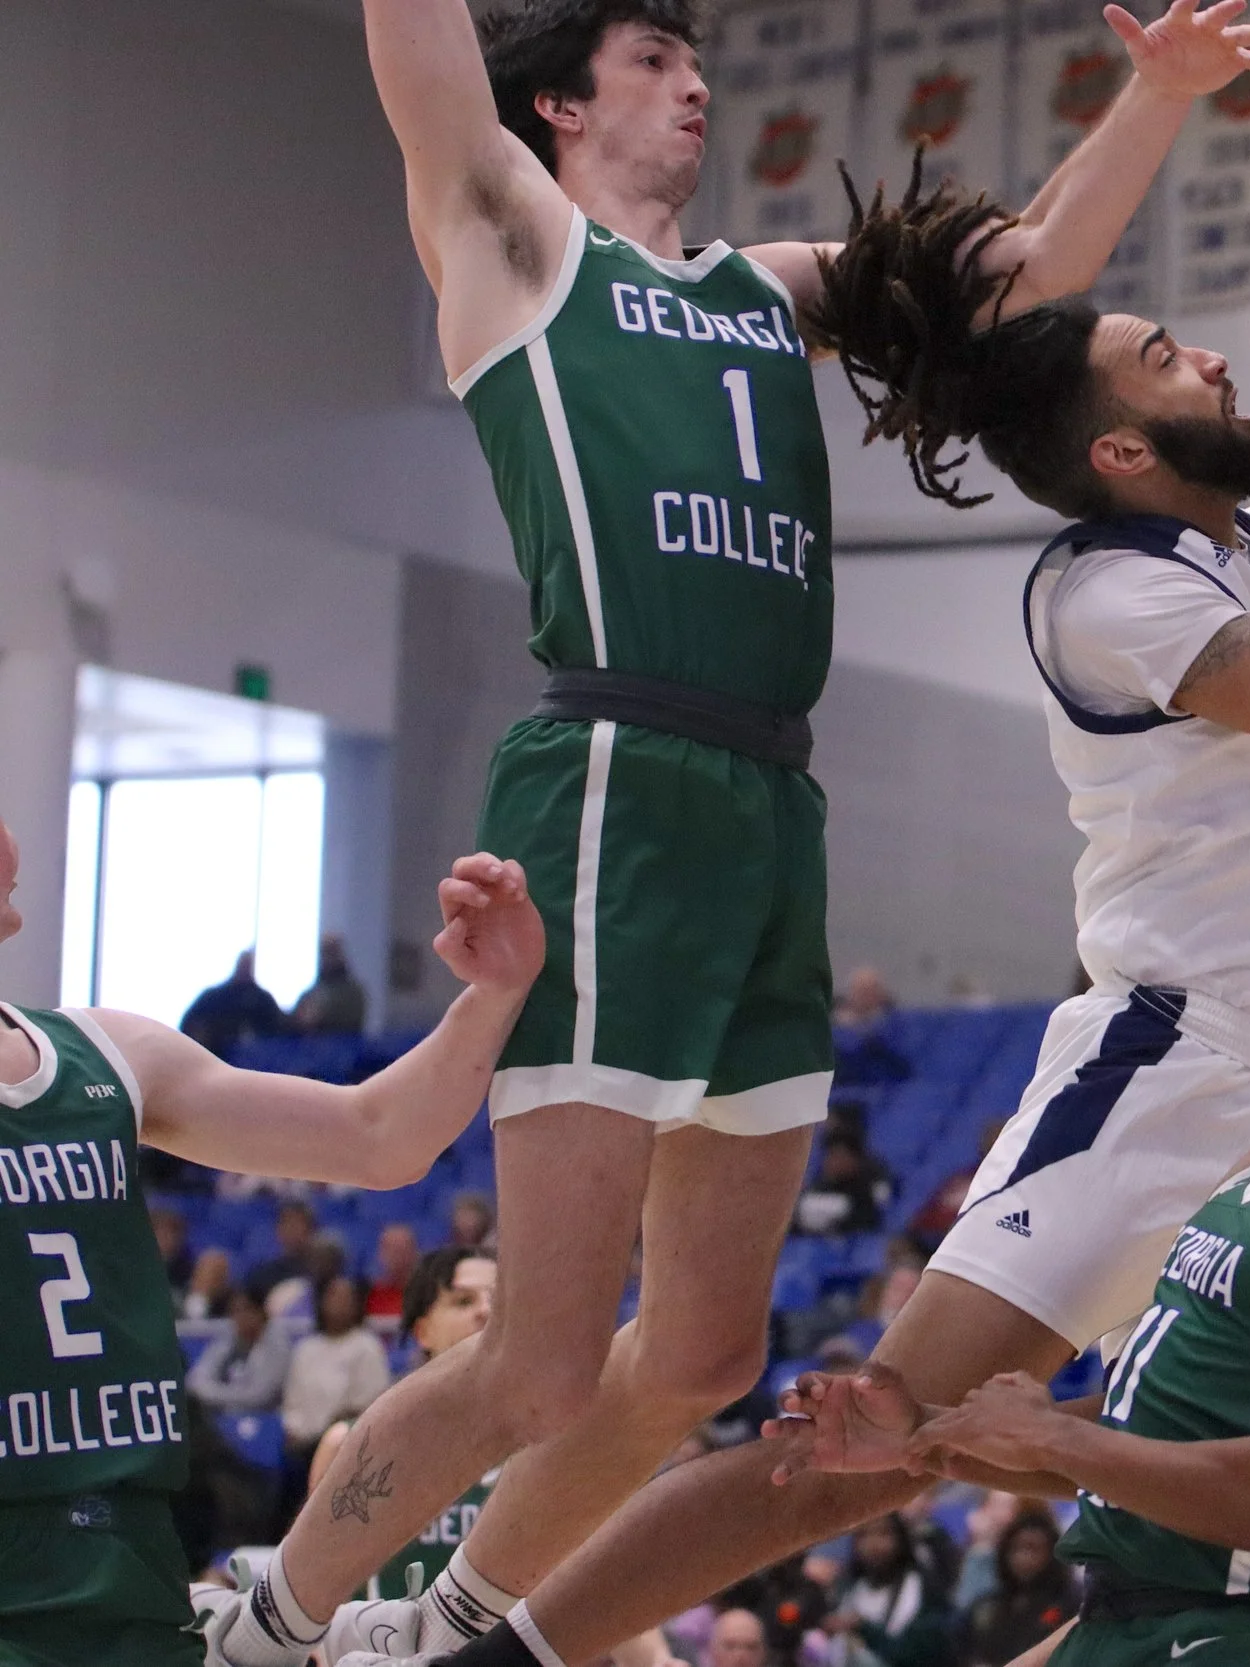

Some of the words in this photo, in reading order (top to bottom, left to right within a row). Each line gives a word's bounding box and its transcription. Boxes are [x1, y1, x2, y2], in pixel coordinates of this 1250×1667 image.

[722, 368, 763, 483] 1
[0, 1139, 128, 1204] ORGIA
[995, 1218, 1032, 1239] adidas
[27, 1231, 103, 1359] 2
[1101, 1303, 1181, 1423] 11
[0, 1380, 183, 1458] OLLEGE
